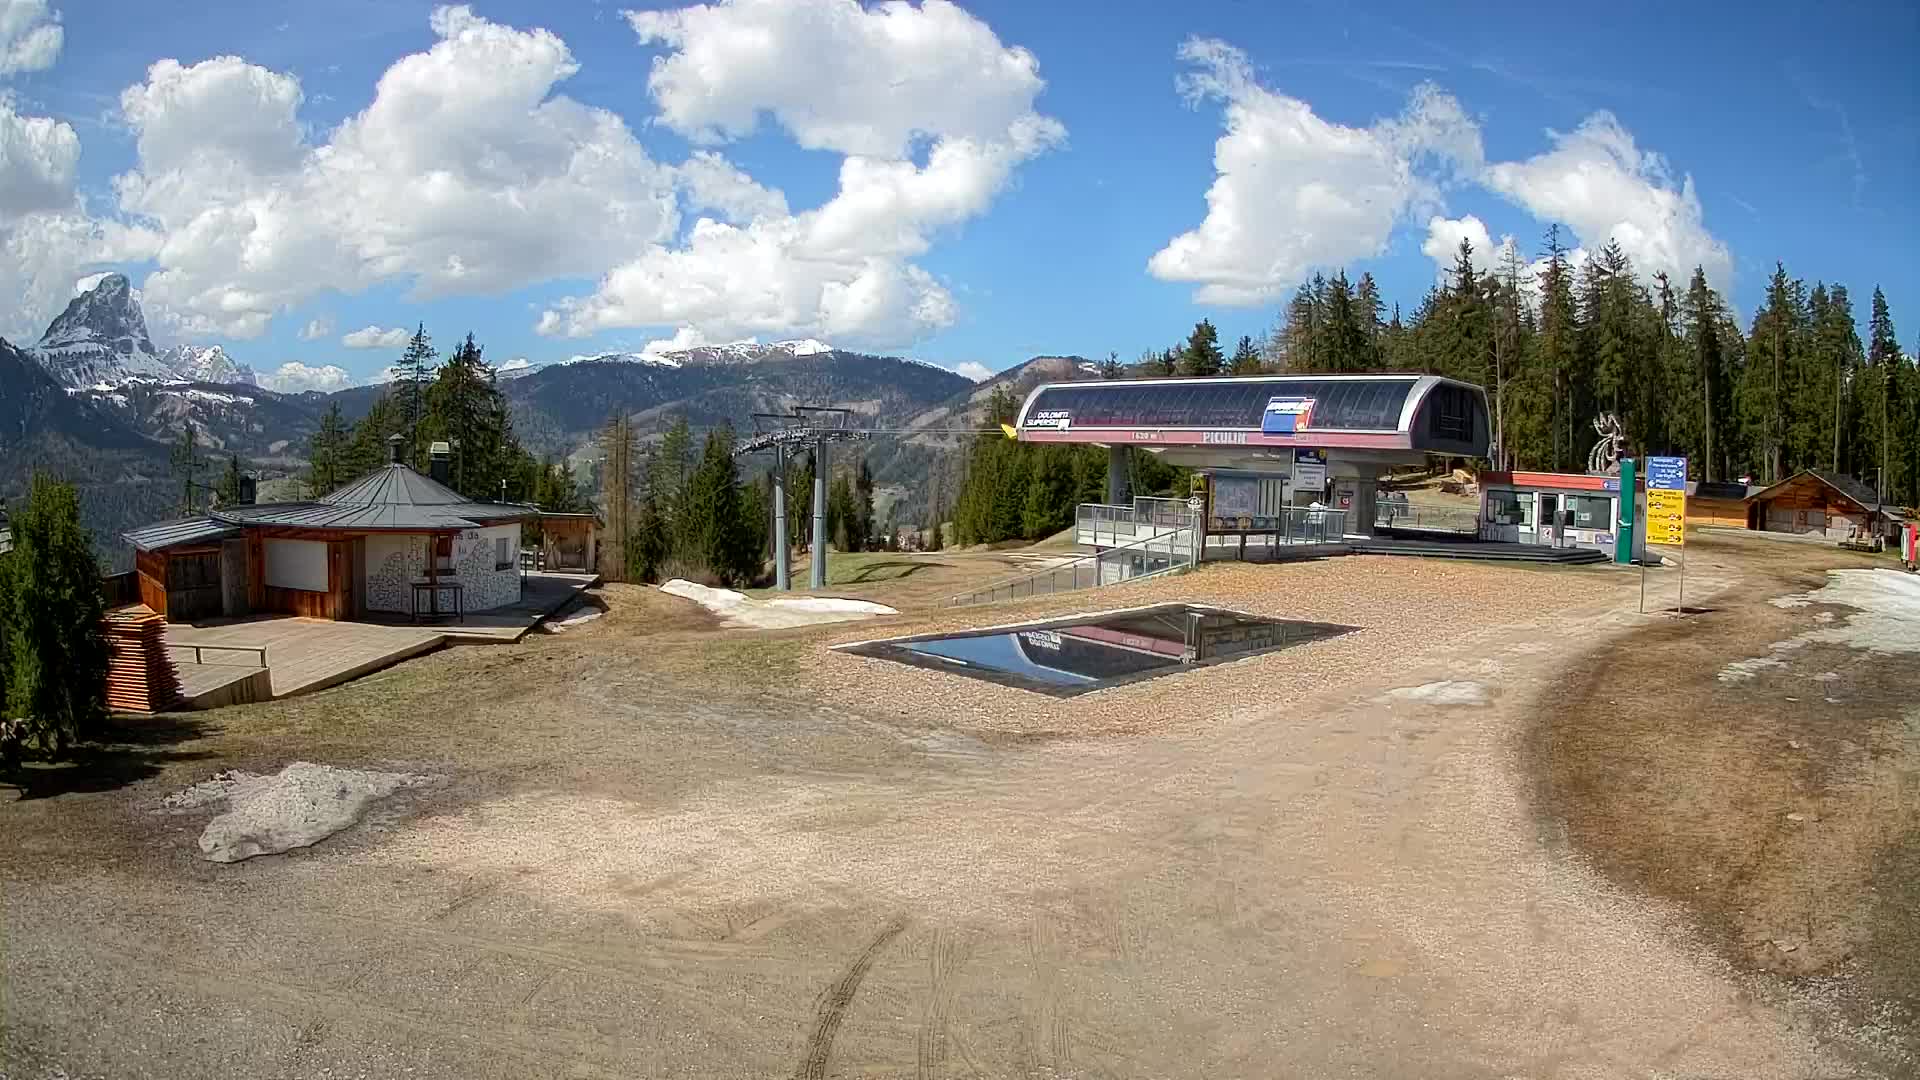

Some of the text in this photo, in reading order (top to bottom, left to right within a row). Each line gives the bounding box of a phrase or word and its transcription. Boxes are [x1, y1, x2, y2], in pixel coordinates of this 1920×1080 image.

[1037, 411, 1069, 419] DOLOMITI
[1026, 418, 1059, 426] SUPERSKI
[1203, 431, 1247, 444] PICULIN
